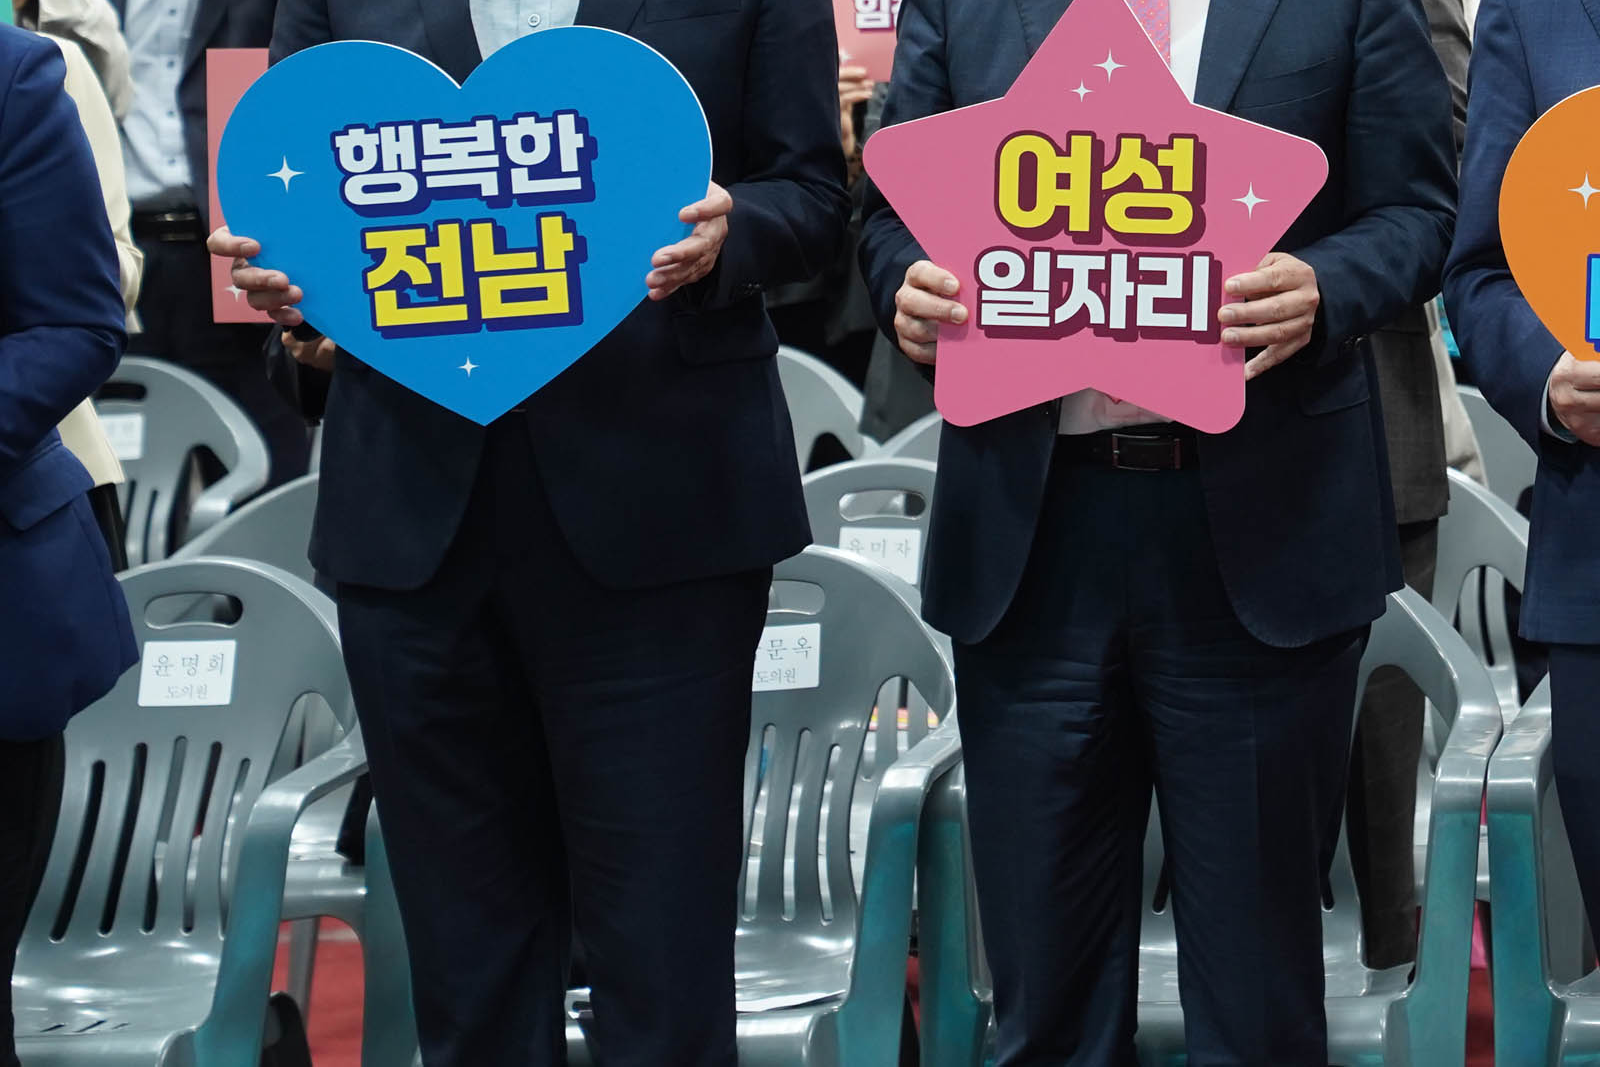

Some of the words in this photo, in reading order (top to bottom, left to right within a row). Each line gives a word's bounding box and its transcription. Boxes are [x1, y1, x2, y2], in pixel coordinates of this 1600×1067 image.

[332, 111, 594, 216] 행복한
[996, 132, 1206, 242] 여성
[361, 213, 586, 336] 전남
[976, 248, 1220, 341] 일자리
[757, 636, 813, 661] 문옥
